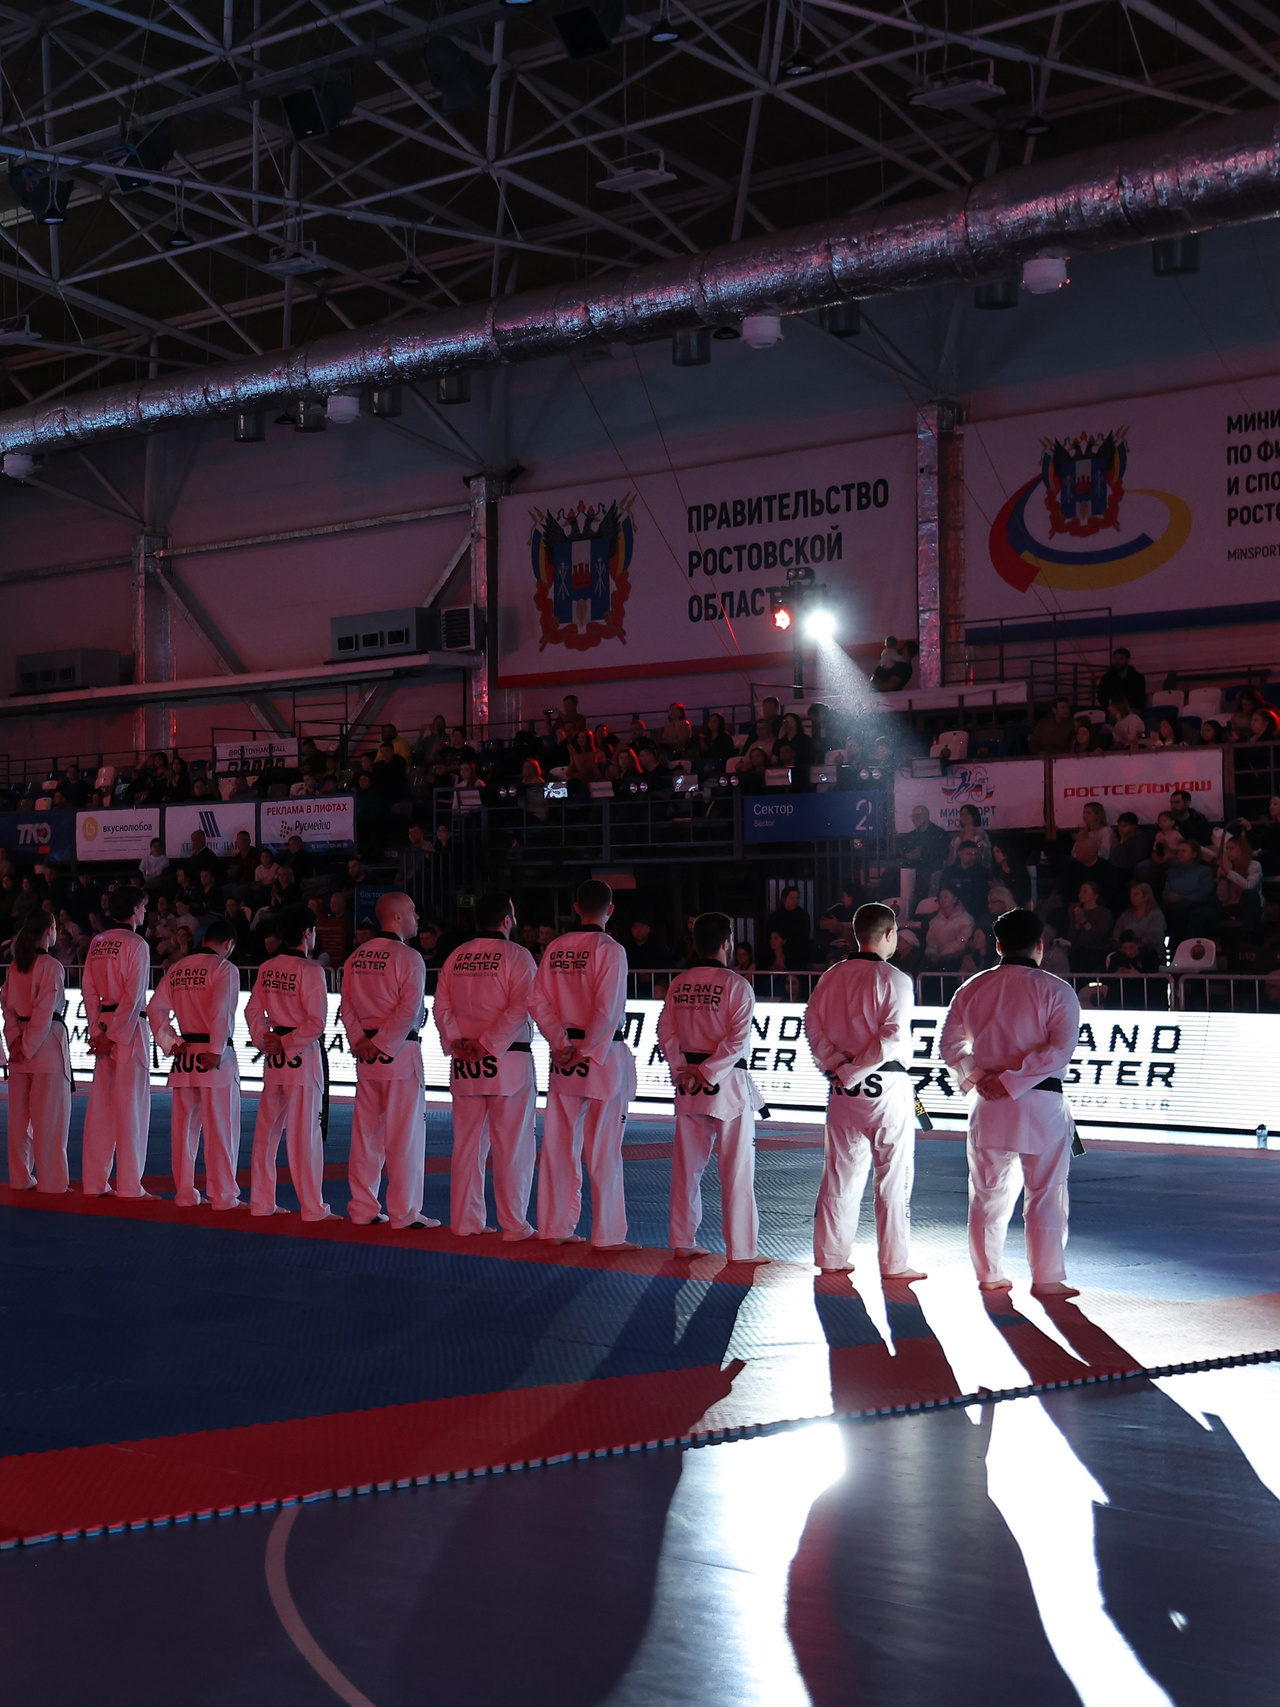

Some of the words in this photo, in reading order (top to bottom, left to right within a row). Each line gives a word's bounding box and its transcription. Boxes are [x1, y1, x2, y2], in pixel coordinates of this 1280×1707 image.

[1227, 445, 1251, 465] ПО
[1227, 477, 1239, 496] И
[687, 478, 889, 533] ПРАВИТЕЛЬСТВО
[688, 525, 842, 577] РОСТОВСКОЙ
[1063, 780, 1212, 798] РОСТСЕЛЬМАШ
[266, 805, 305, 816] РЕКЛАМА
[306, 805, 313, 814] В
[313, 803, 348, 814] ЛИФТАХ
[753, 803, 794, 816] Сектор
[855, 799, 873, 831] 2
[102, 821, 152, 834] вкуснолюбов
[453, 961, 500, 971] MASTER
[456, 952, 502, 962] GRAND
[453, 1055, 498, 1080] RUS
